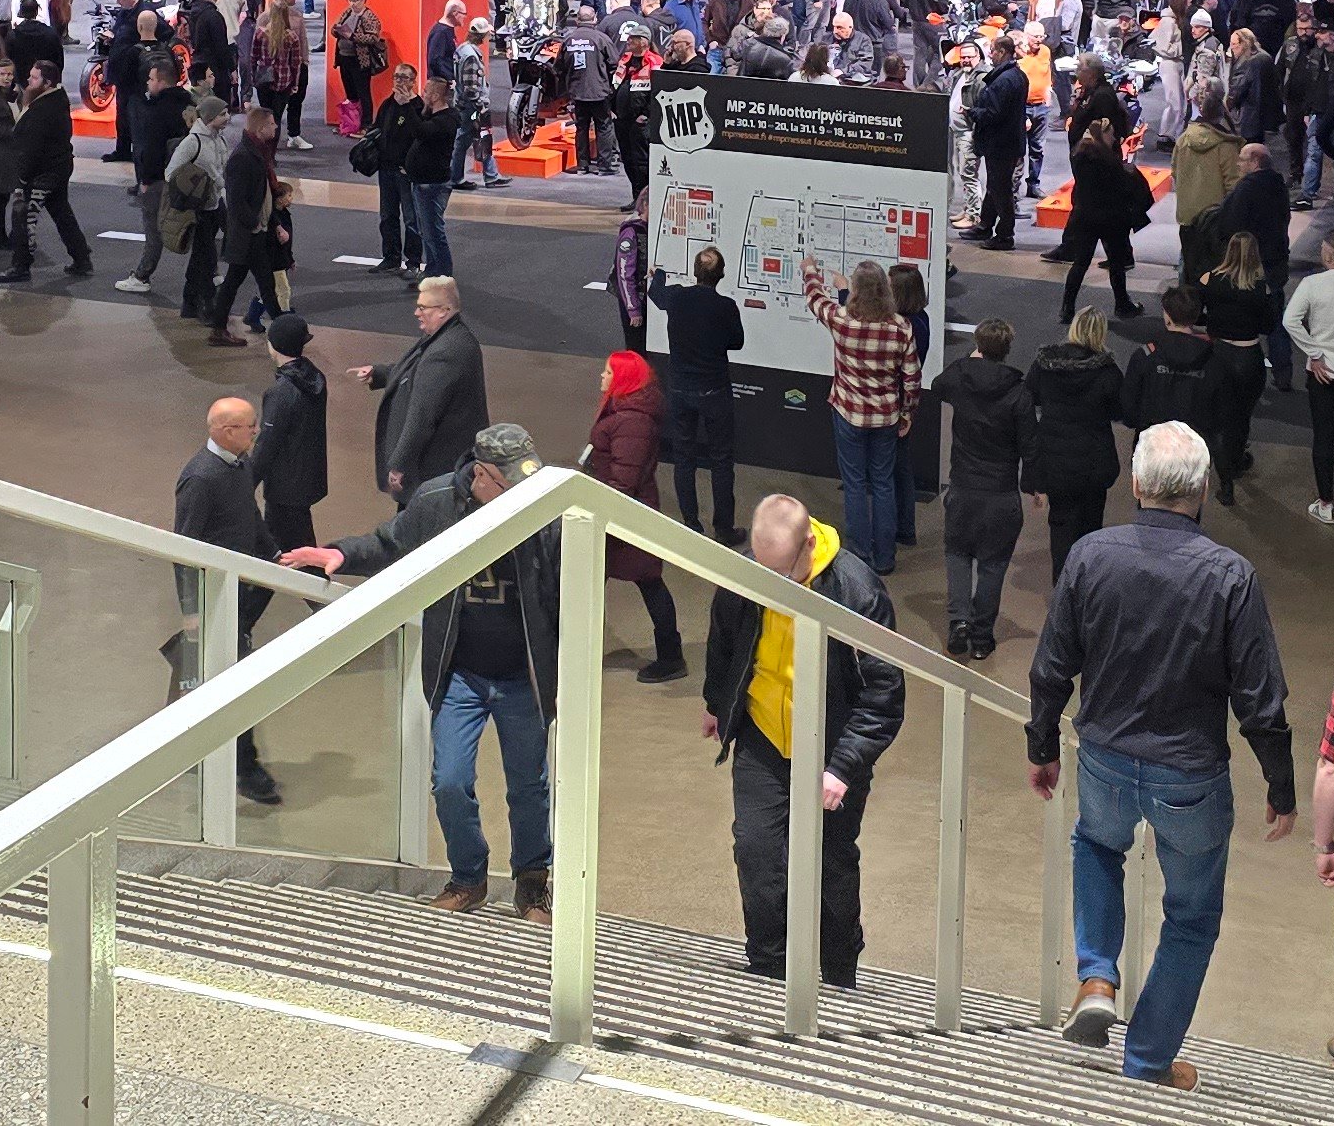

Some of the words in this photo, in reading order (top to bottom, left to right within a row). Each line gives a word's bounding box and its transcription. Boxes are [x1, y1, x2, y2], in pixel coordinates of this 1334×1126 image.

[665, 102, 704, 138] MP
[726, 99, 747, 113] MP
[749, 102, 766, 115] 26
[768, 103, 903, 128] Moottoripyörämessut
